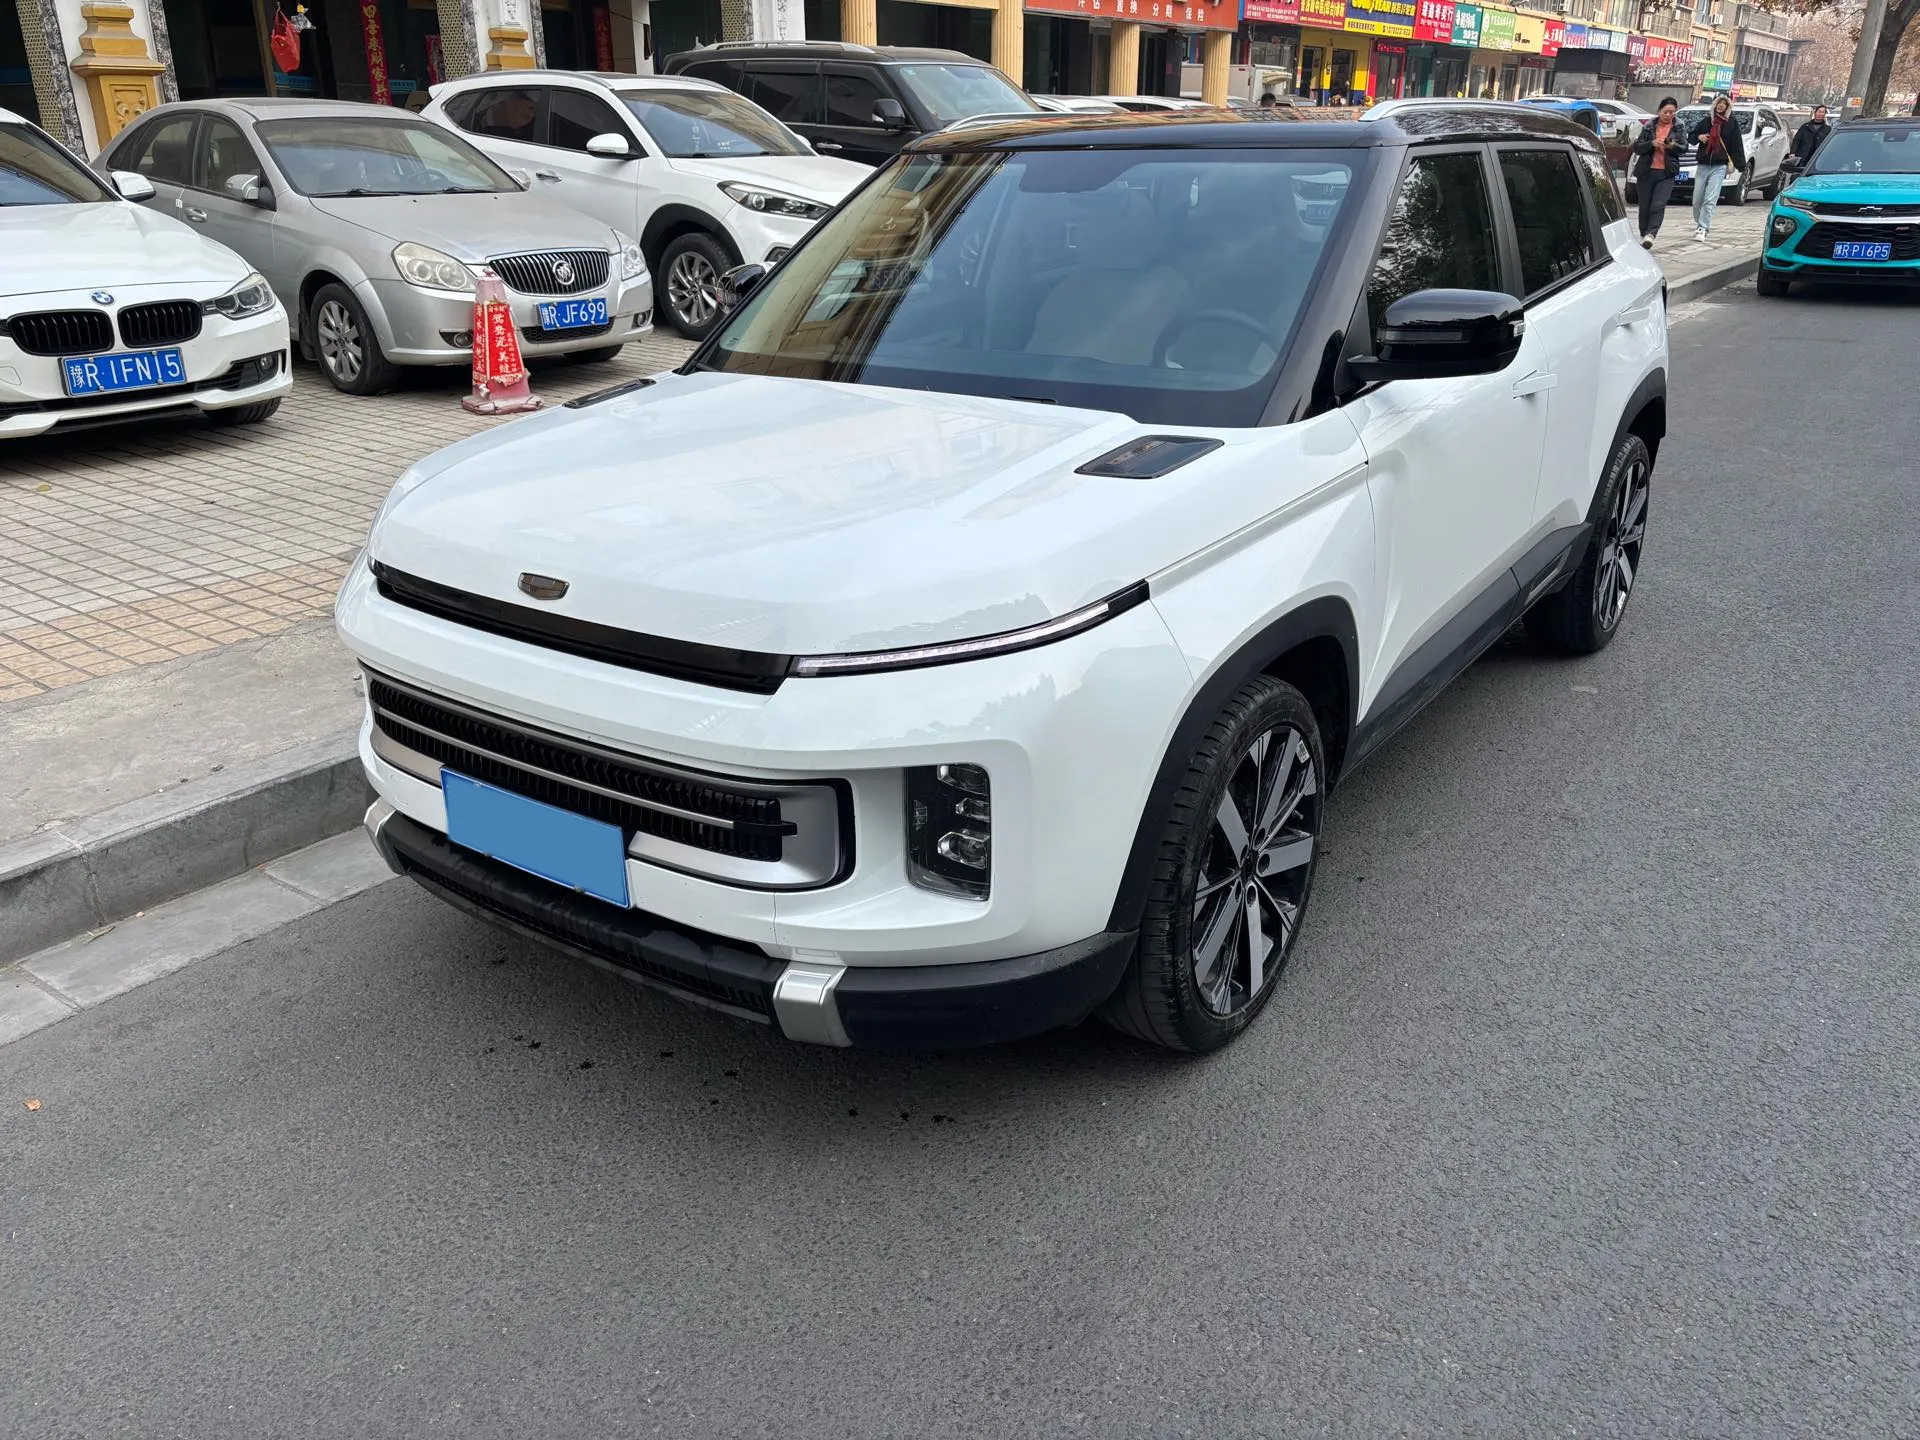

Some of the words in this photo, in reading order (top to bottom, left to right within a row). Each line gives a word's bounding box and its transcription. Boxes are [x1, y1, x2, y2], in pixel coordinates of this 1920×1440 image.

[1116, 0, 1138, 15] 置换
[1152, 4, 1173, 19] 分期
[1186, 7, 1205, 22] 保险
[70, 353, 182, 389] 豫R·1FN15
